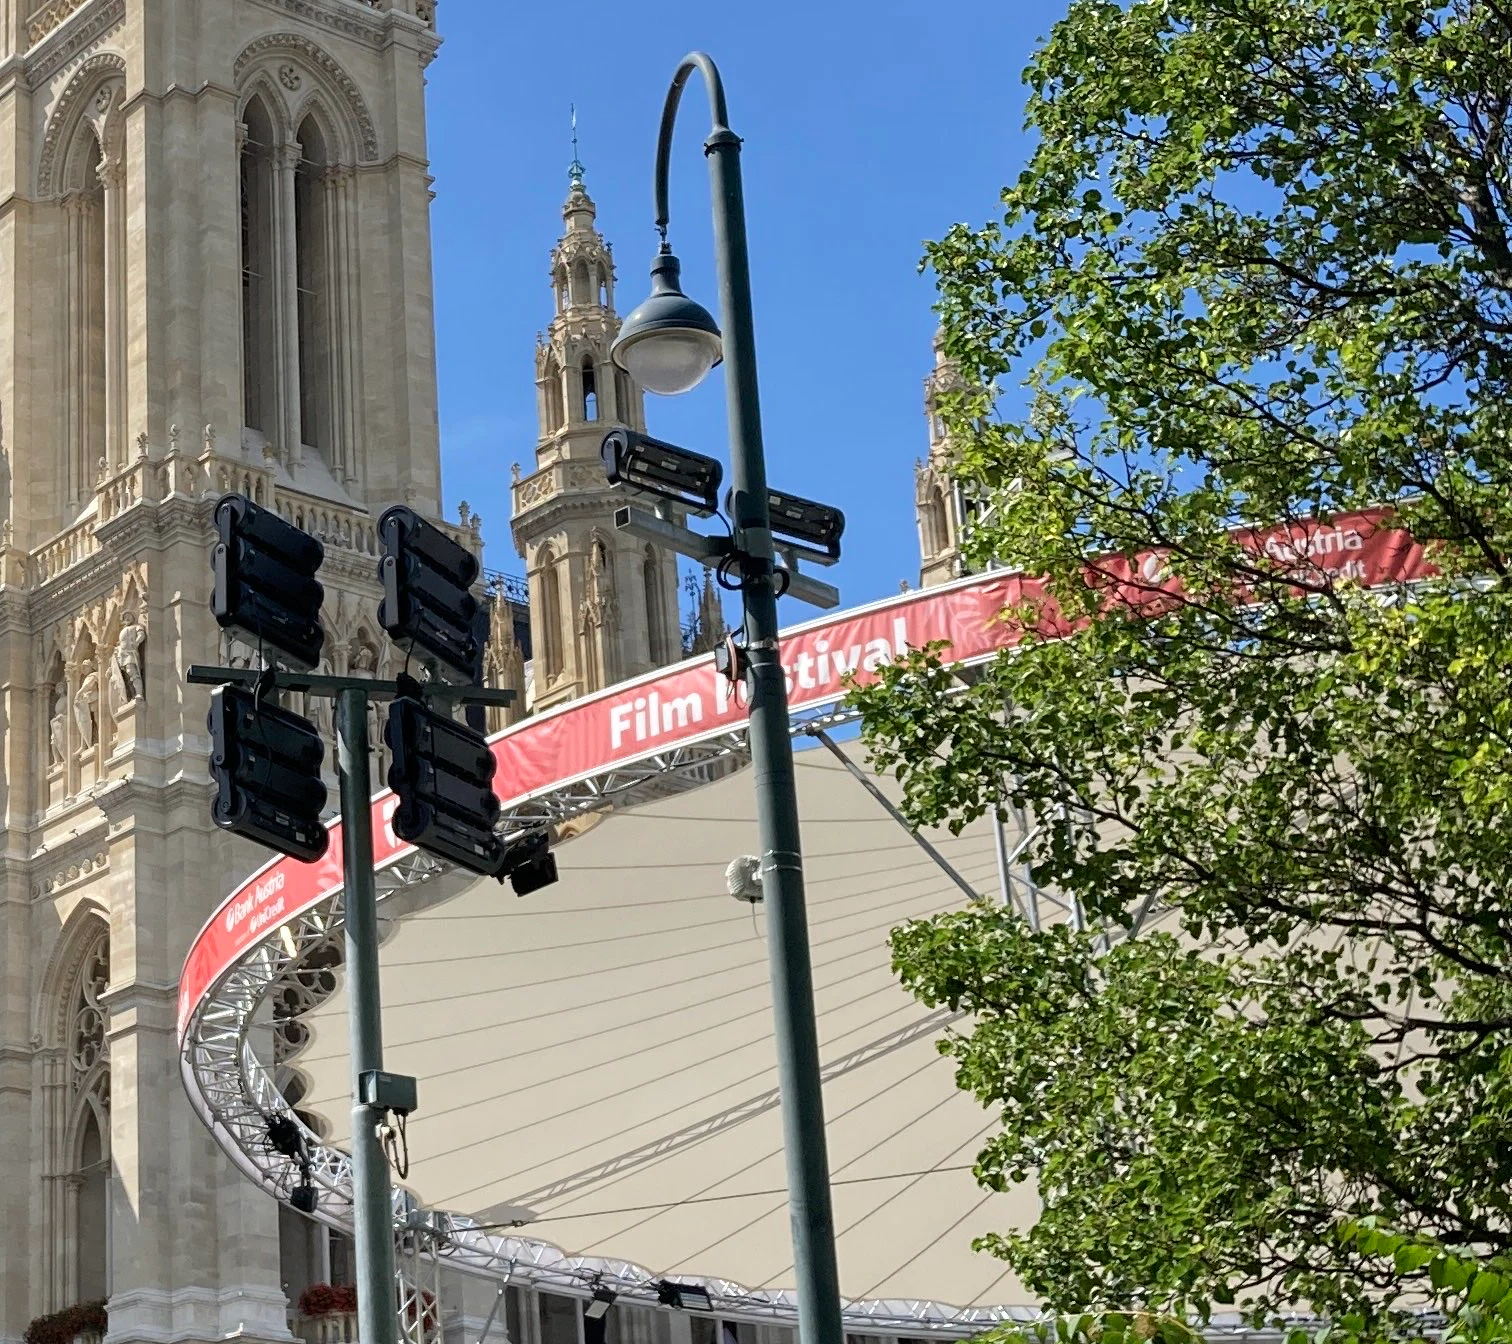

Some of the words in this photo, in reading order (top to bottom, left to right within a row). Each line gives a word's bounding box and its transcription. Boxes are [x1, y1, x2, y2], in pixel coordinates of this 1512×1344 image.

[610, 691, 703, 750] Film
[714, 617, 909, 716] Fstival
[234, 892, 254, 926] Bank
[254, 870, 285, 909] Austria
